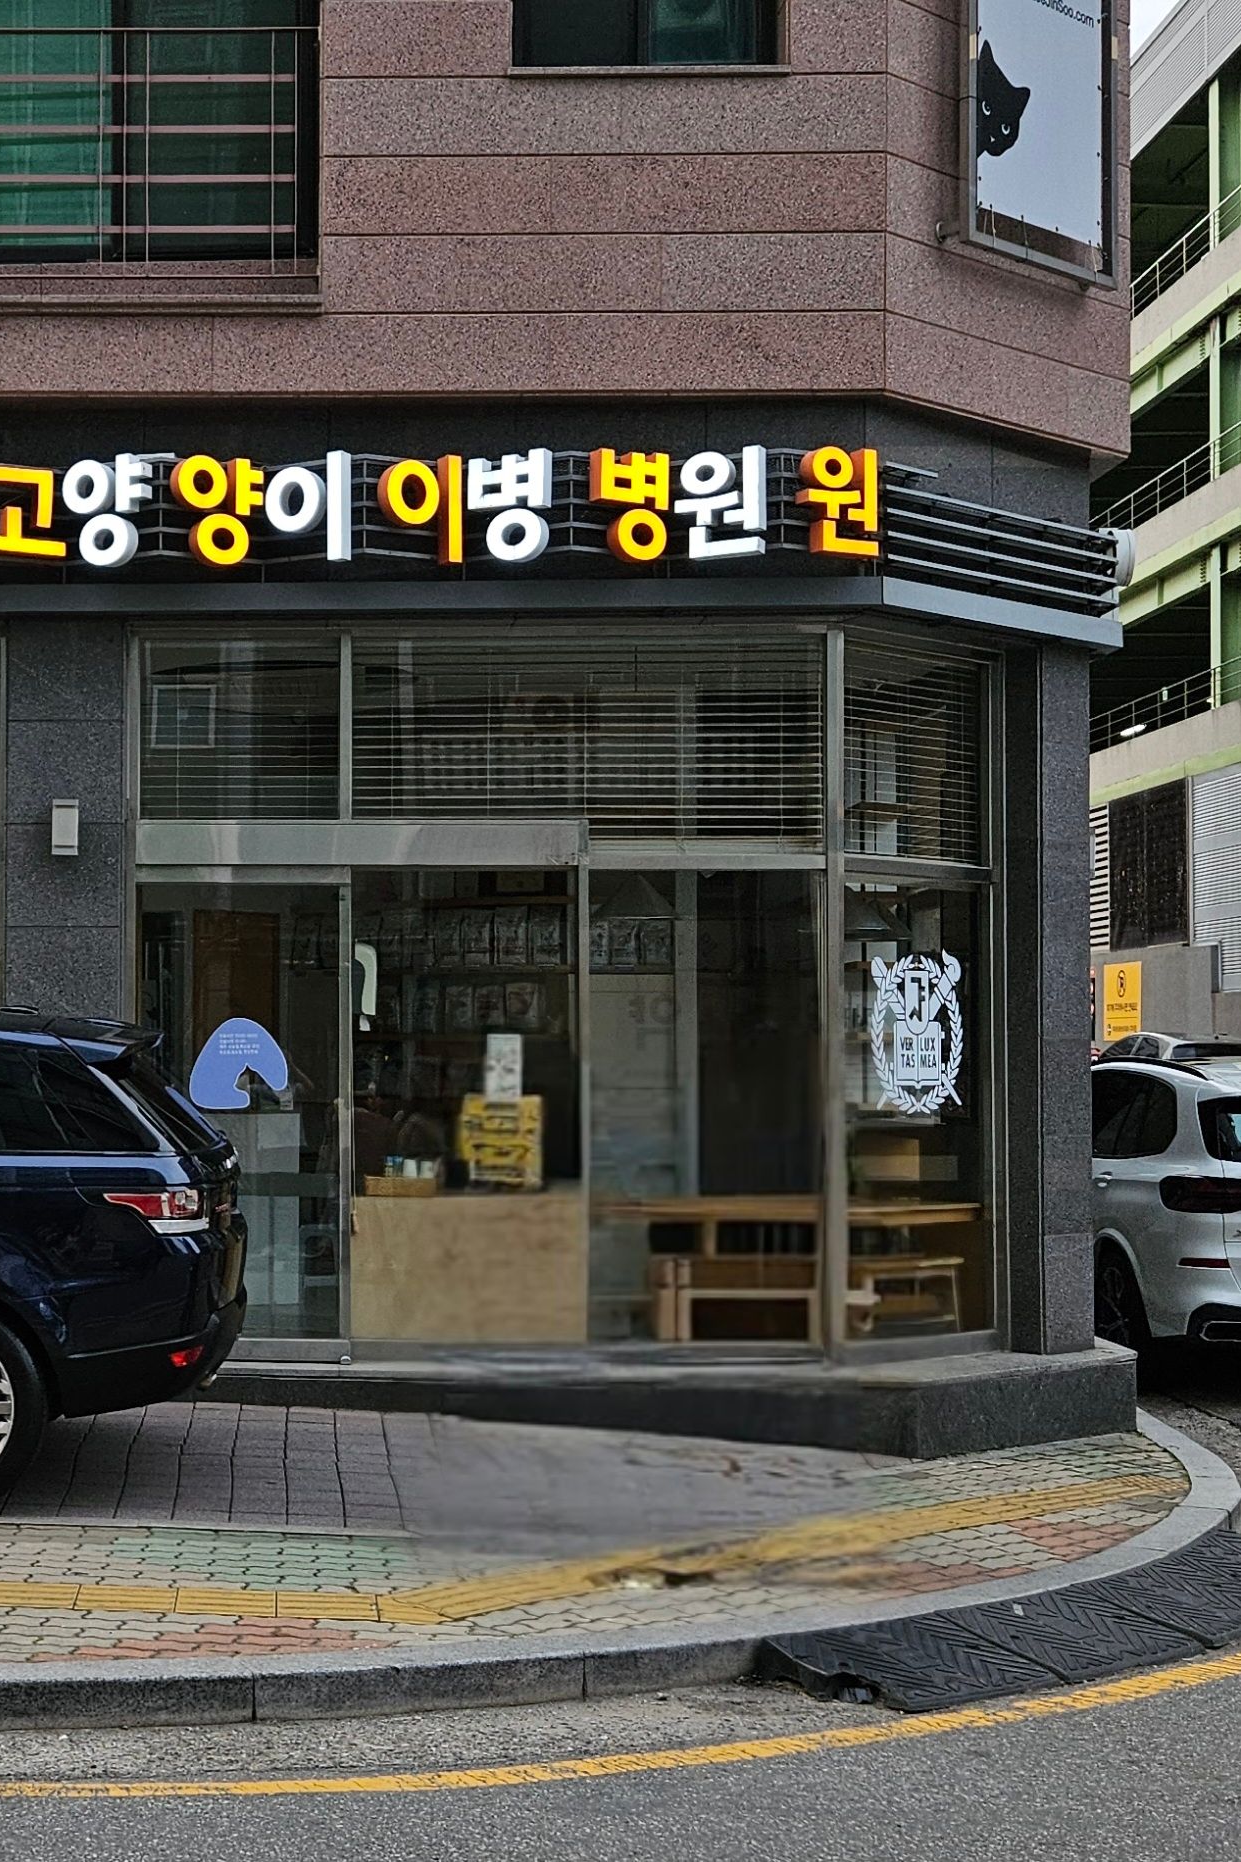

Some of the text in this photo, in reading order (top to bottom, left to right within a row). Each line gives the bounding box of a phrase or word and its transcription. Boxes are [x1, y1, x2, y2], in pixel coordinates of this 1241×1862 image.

[920, 1037, 936, 1052] LUX
[901, 1053, 937, 1069] TAS MEA
